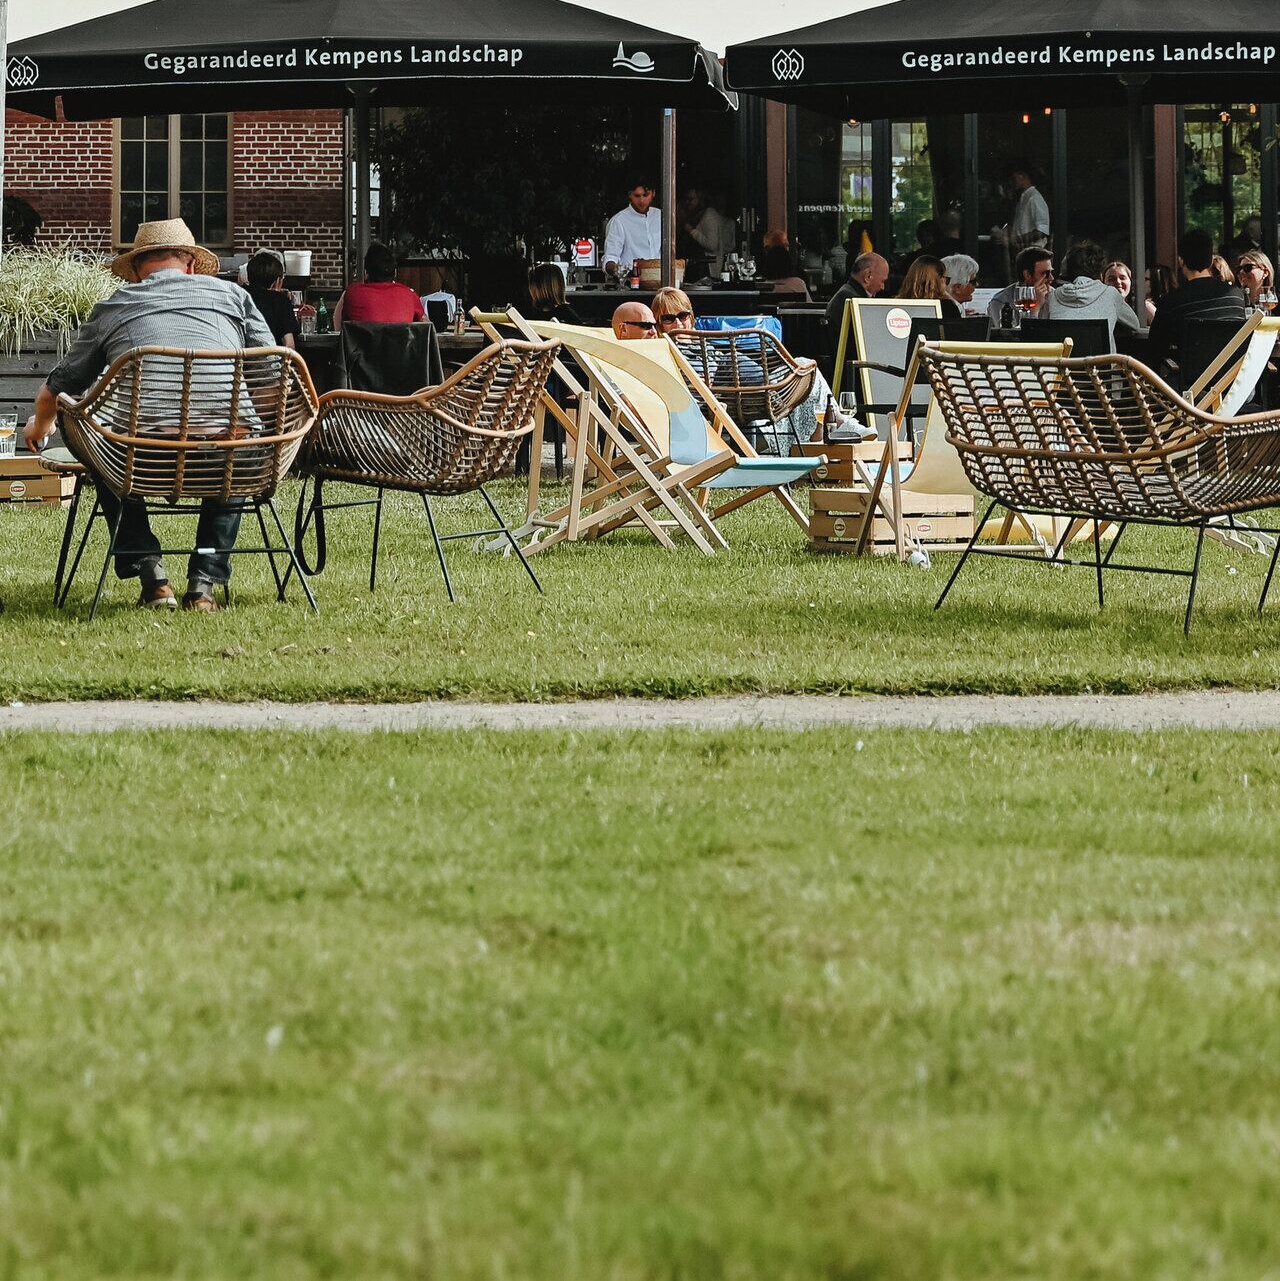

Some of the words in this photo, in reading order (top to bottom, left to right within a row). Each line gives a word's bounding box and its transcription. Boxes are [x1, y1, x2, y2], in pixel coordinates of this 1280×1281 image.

[144, 49, 297, 74] Gegarandeerd
[305, 47, 403, 69] Kempens
[410, 45, 523, 67] Landschap
[901, 46, 1051, 72] Gegarandeerd
[1058, 46, 1156, 68] Kempens
[1163, 41, 1276, 65] Landschap
